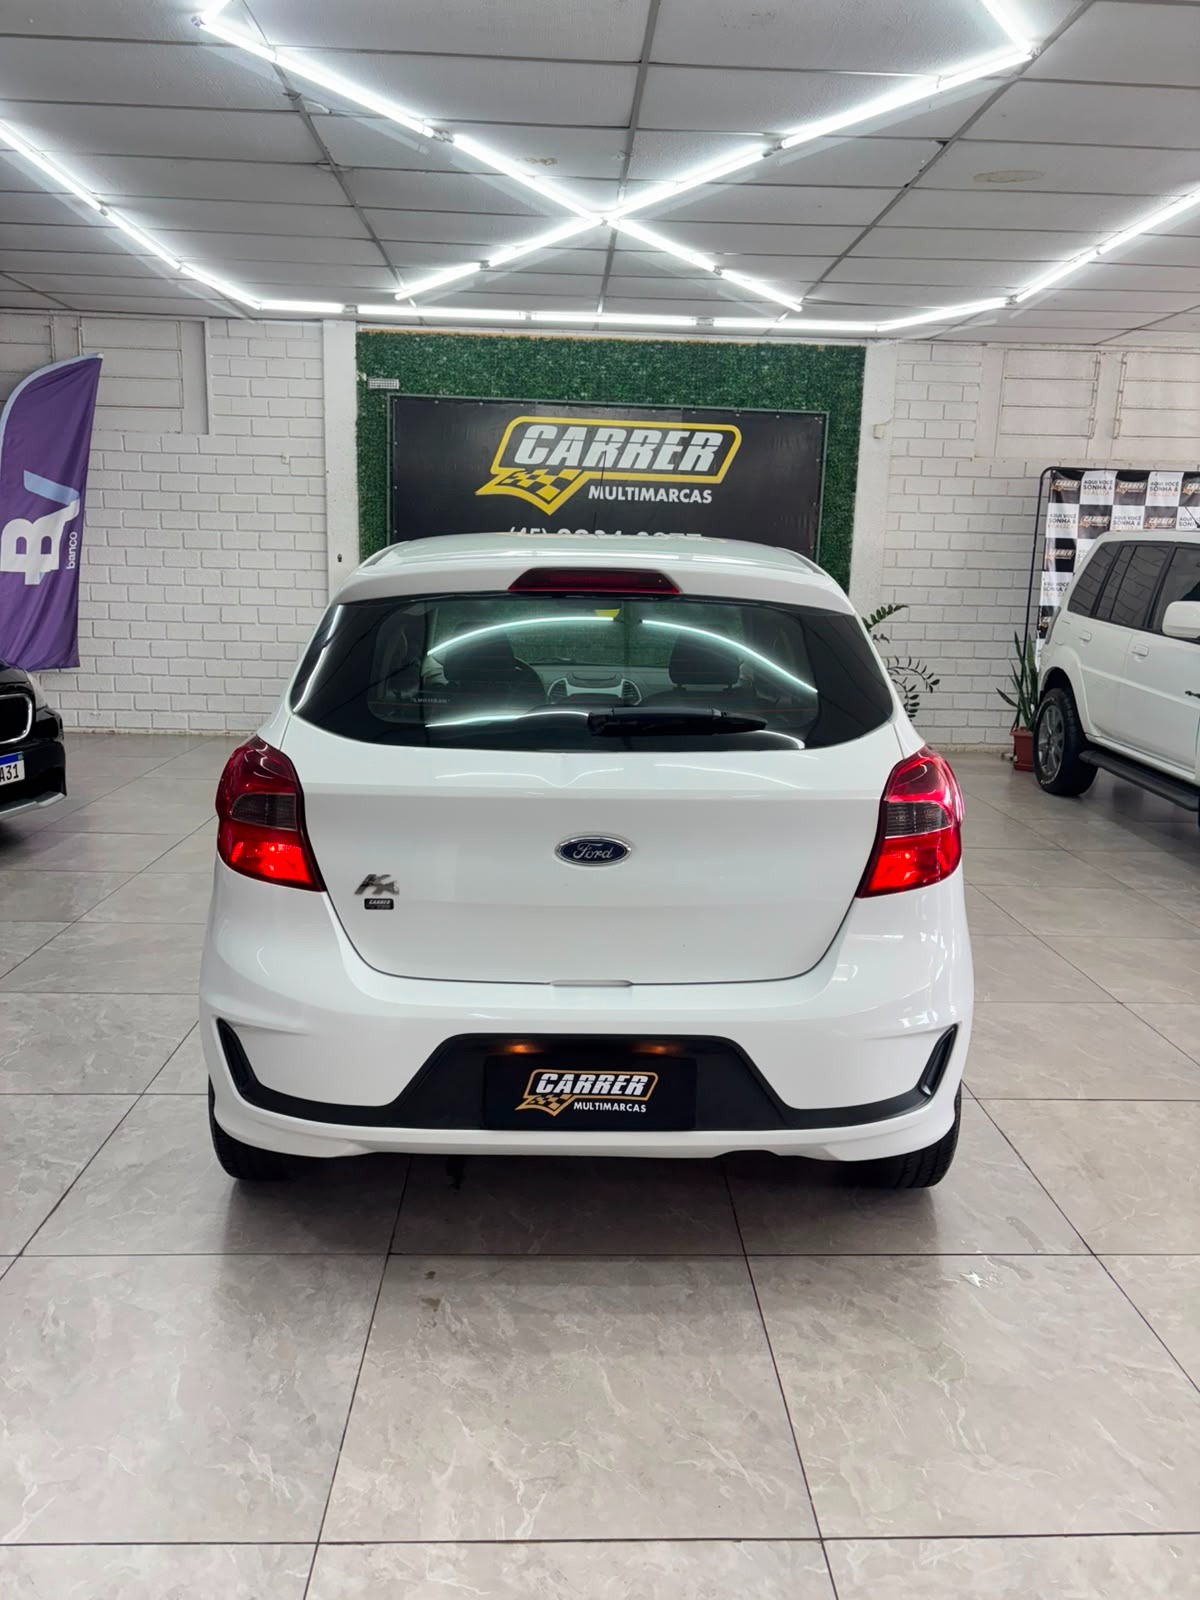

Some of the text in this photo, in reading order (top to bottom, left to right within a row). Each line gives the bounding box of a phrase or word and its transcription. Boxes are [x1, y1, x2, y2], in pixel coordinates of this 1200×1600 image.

[514, 424, 723, 472] CARRER
[588, 485, 713, 504] MULTIMARCAS
[66, 531, 78, 570] banco
[572, 843, 613, 859] Ford
[536, 1073, 649, 1096] CARRER
[573, 1101, 647, 1113] MULTIMARCAS
